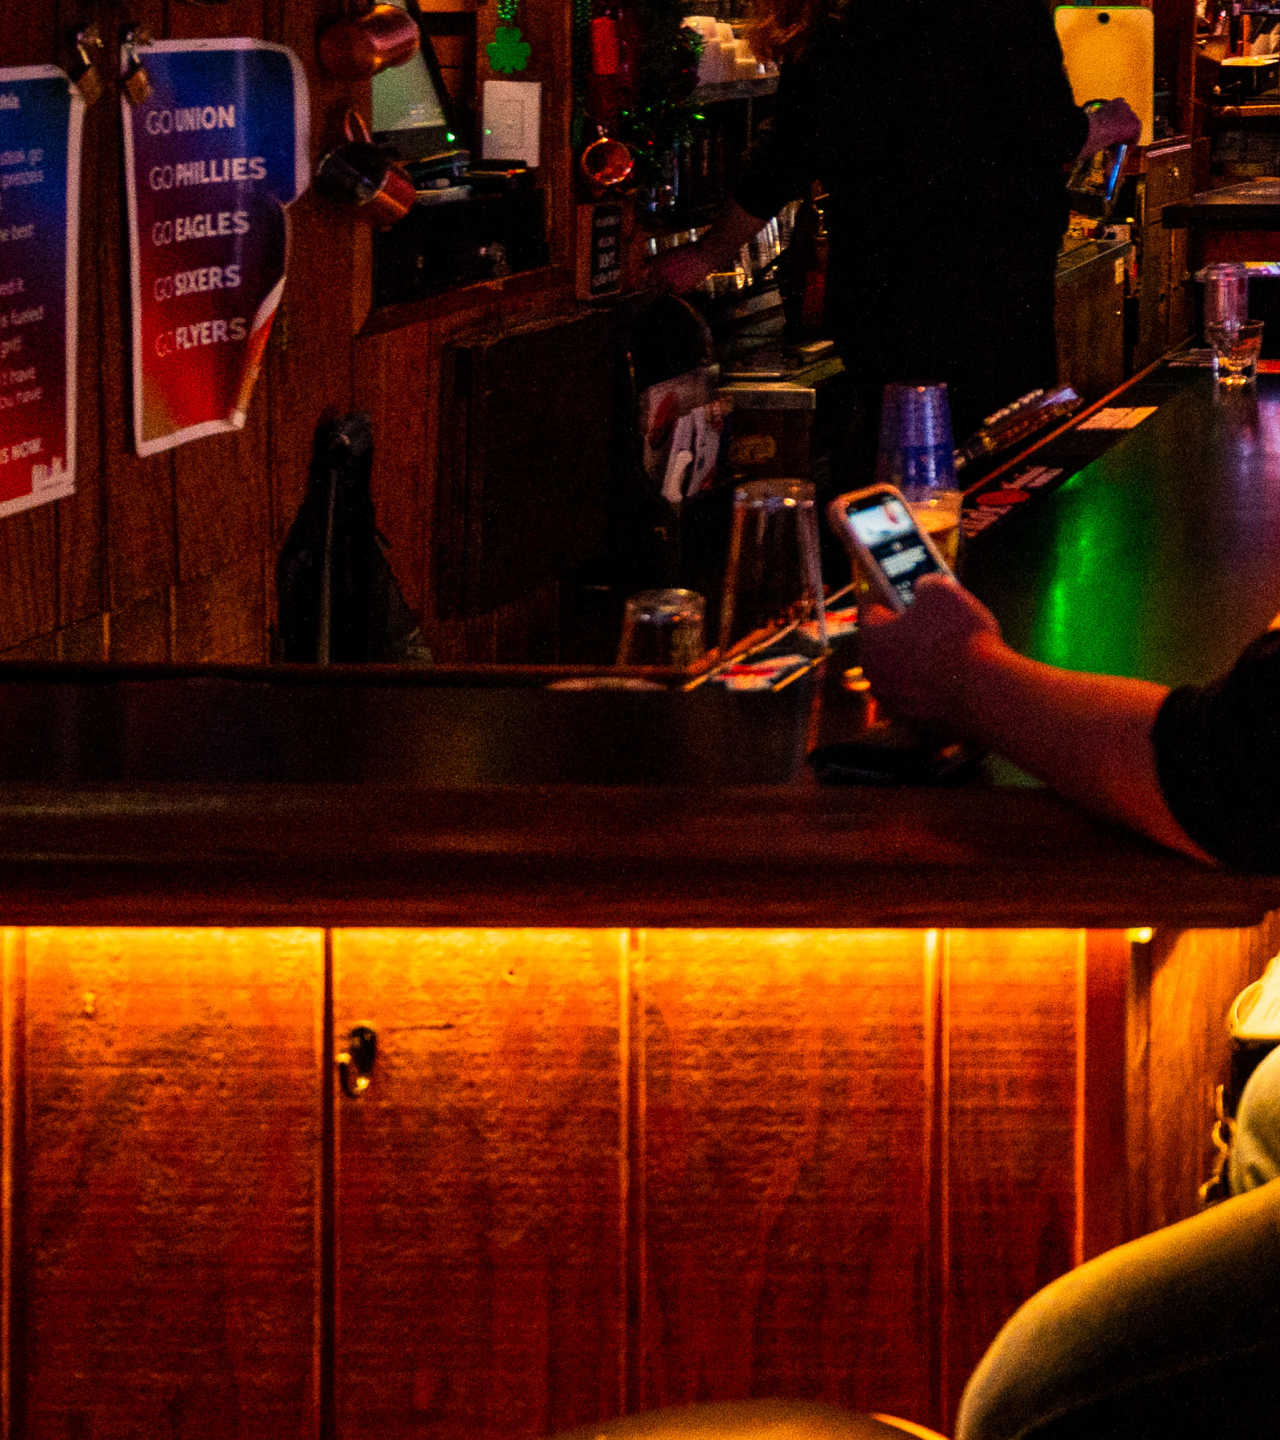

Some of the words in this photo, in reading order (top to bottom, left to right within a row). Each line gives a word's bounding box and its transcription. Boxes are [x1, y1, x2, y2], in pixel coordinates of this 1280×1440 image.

[146, 110, 172, 136] GO
[173, 105, 236, 133] UNION
[149, 166, 175, 190] GO
[175, 156, 267, 188] PHILLIES
[152, 221, 173, 248] GO
[174, 211, 251, 244] EAGLES
[174, 263, 241, 298] SIXERS
[175, 316, 248, 350] FLYERS
